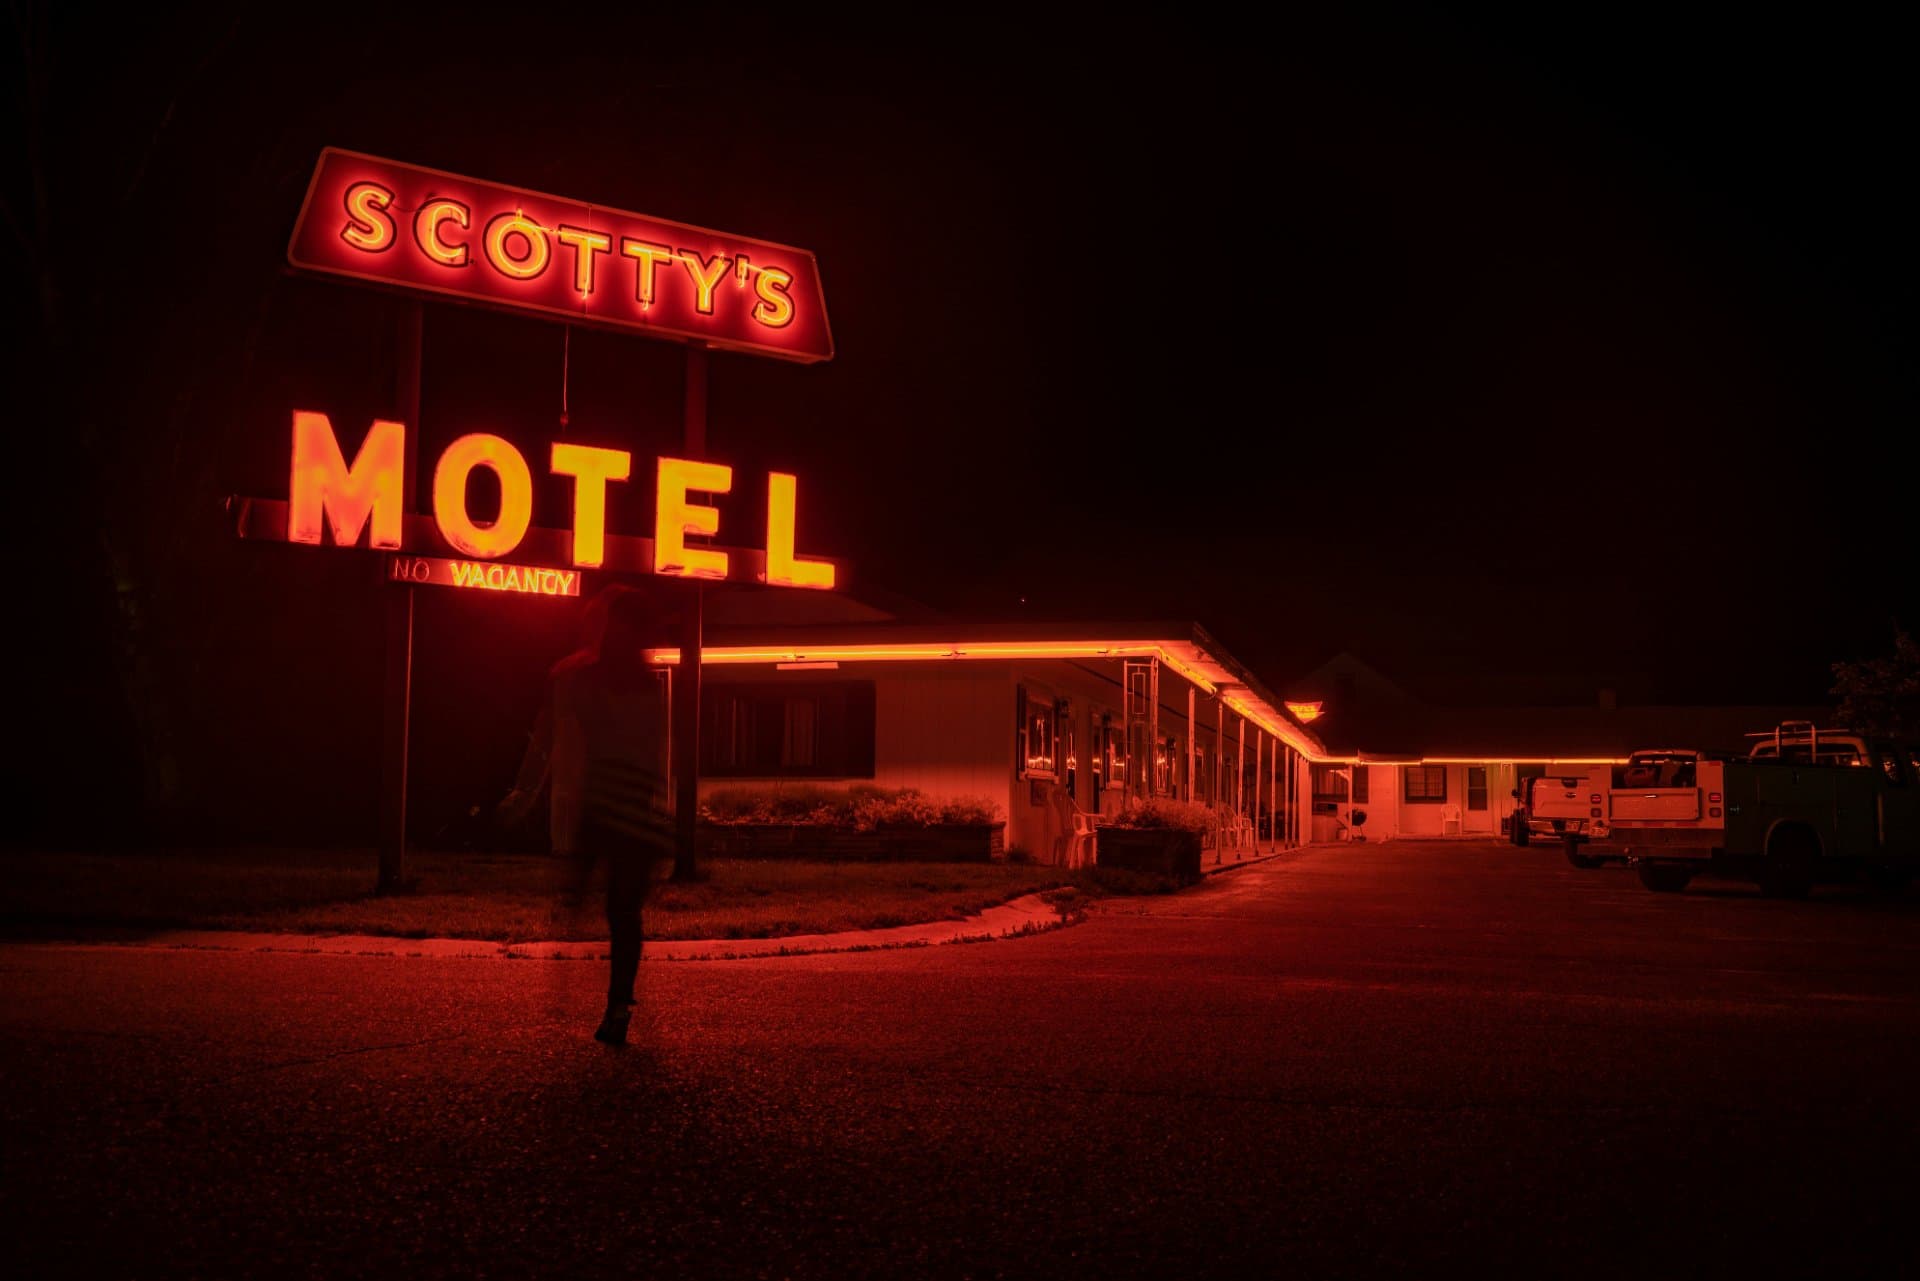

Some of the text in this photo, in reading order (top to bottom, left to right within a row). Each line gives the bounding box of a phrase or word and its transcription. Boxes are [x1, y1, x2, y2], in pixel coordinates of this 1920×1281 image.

[341, 181, 796, 329] SCOTTY'S
[288, 410, 835, 589] MOTEL
[393, 558, 575, 595] NO VACANCY
